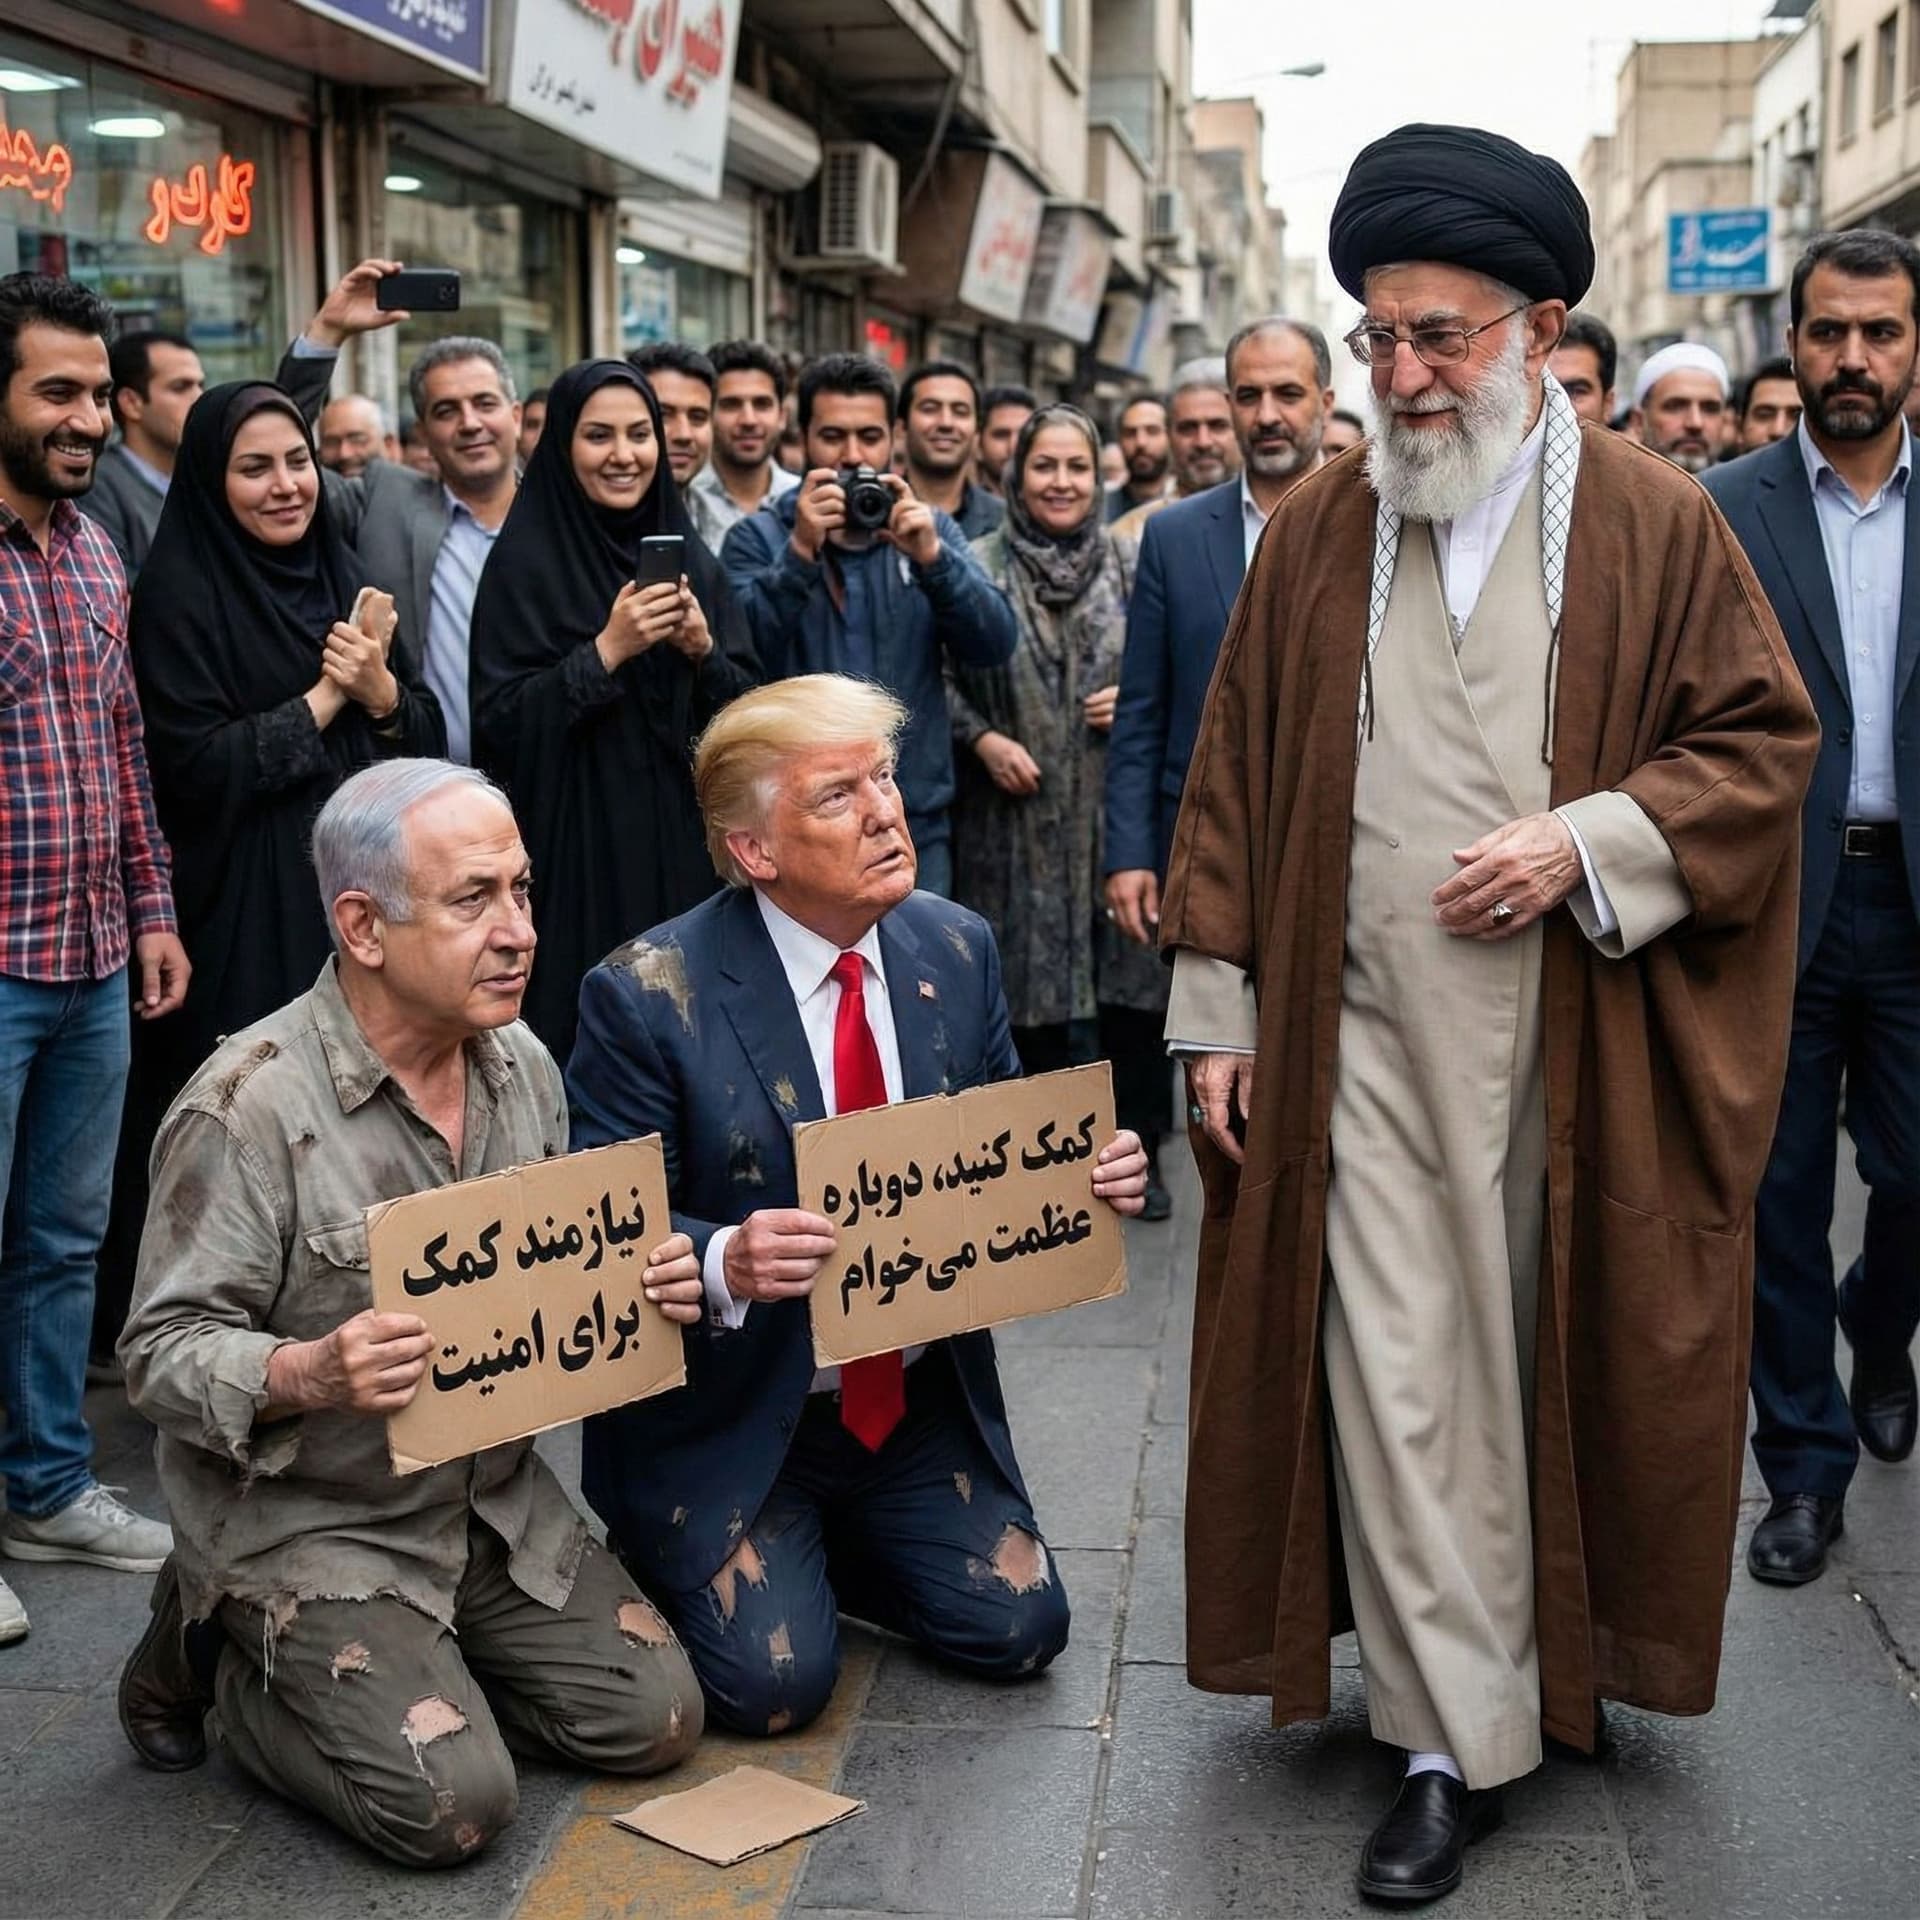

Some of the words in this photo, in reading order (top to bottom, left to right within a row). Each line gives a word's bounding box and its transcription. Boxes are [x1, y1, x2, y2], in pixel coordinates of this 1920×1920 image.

[933, 1129, 1011, 1196] کنید،
[1021, 1112, 1096, 1171] کمک
[516, 1187, 645, 1271] نیازمند
[823, 1159, 924, 1227] دوباره
[402, 1219, 502, 1297] کمک
[986, 1203, 1092, 1263] عظمت
[431, 1308, 545, 1396] امنیت
[557, 1290, 640, 1372] برای
